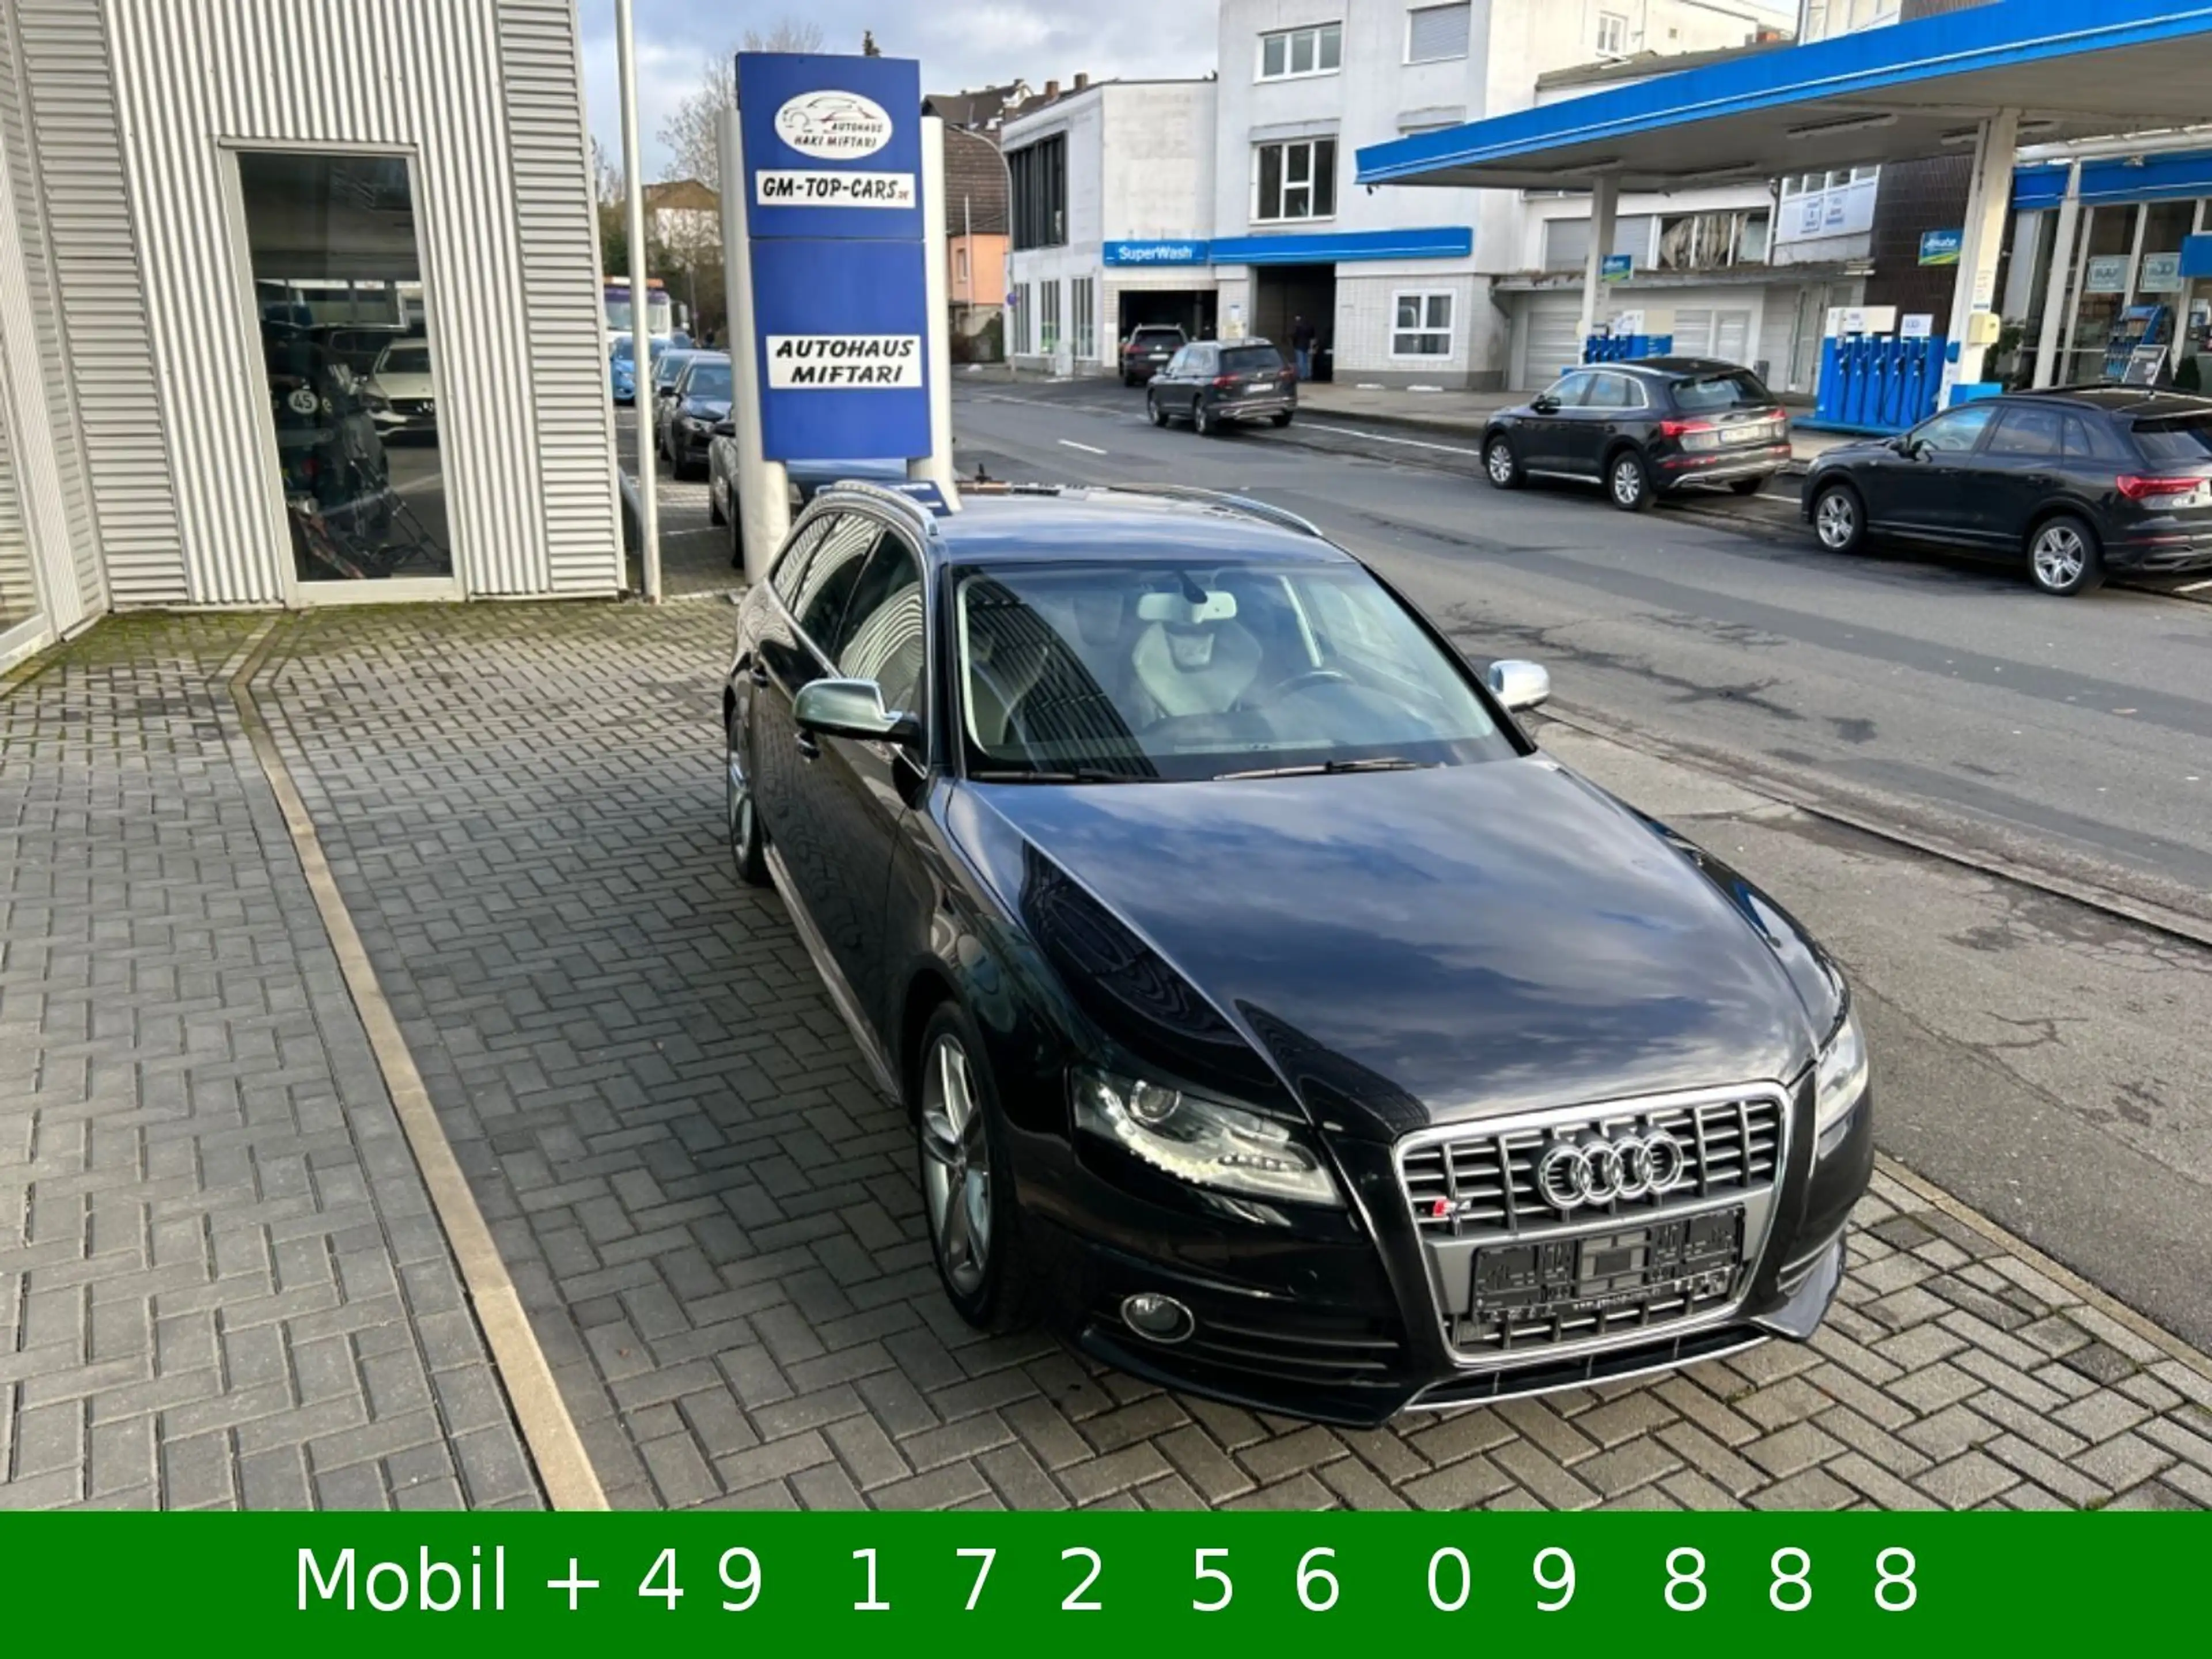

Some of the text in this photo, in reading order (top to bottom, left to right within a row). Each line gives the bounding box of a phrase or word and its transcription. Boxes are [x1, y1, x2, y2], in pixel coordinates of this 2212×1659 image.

[831, 122, 883, 133] AUTOHAUS
[1119, 245, 1193, 262] SuperWash
[776, 339, 914, 358] AUTOHAUS
[790, 365, 903, 384] MIFTARI
[293, 393, 313, 410] 45
